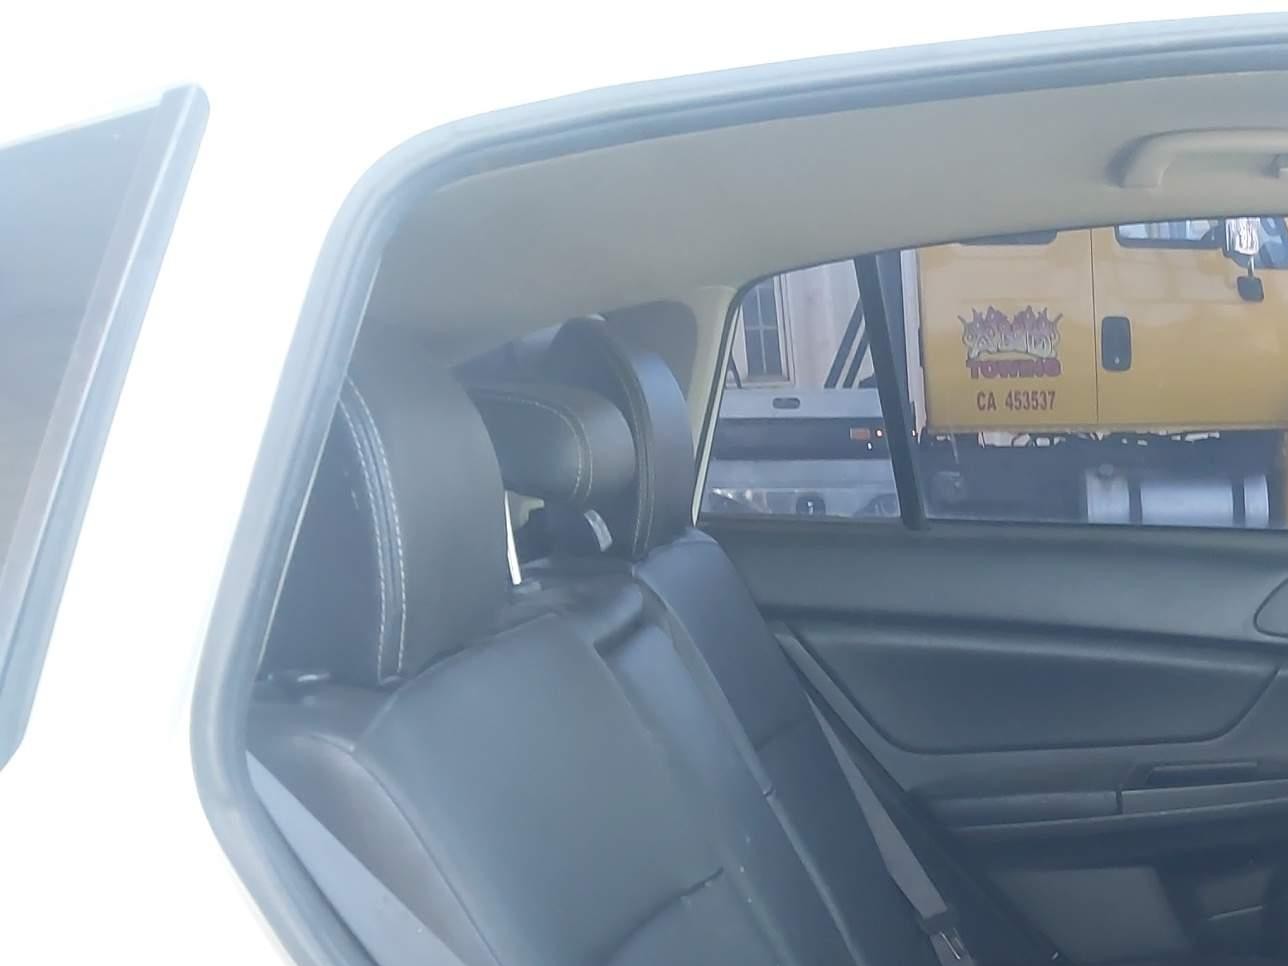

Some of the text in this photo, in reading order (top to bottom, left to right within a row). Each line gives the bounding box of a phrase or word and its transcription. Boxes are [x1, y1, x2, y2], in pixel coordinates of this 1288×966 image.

[966, 358, 1061, 379] TOW
[976, 390, 1056, 411] CA 453537
